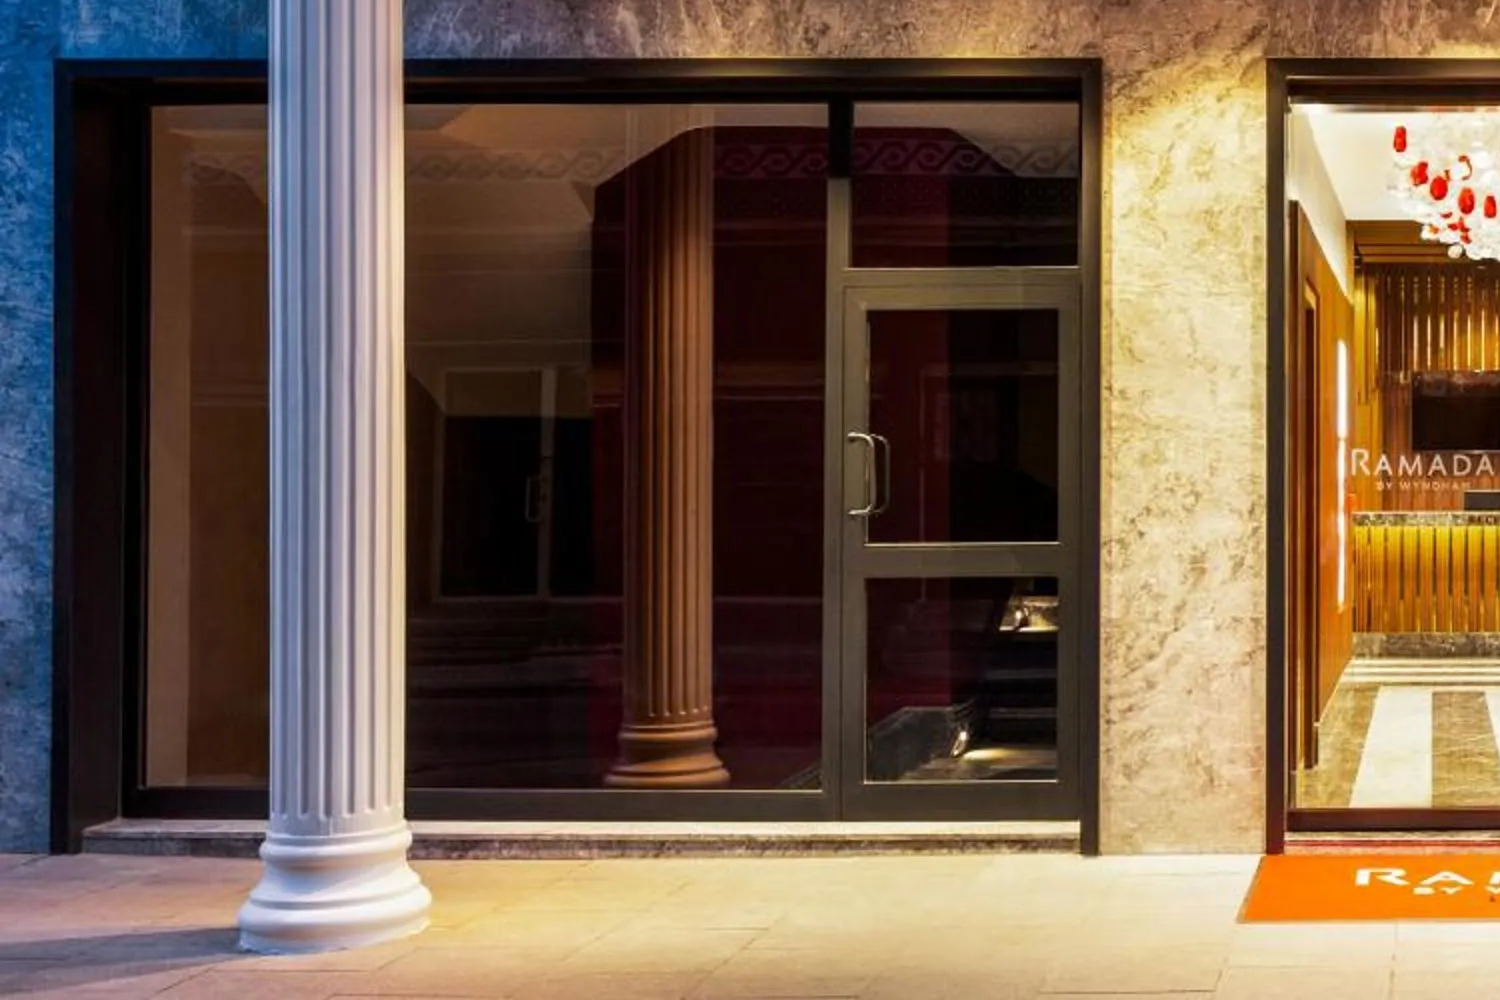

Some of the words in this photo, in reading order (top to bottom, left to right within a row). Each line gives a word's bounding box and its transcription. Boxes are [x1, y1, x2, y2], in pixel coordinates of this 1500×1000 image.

[1350, 448, 1495, 477] RAMADA
[1376, 481, 1393, 491] BY
[1413, 886, 1463, 895] BY
